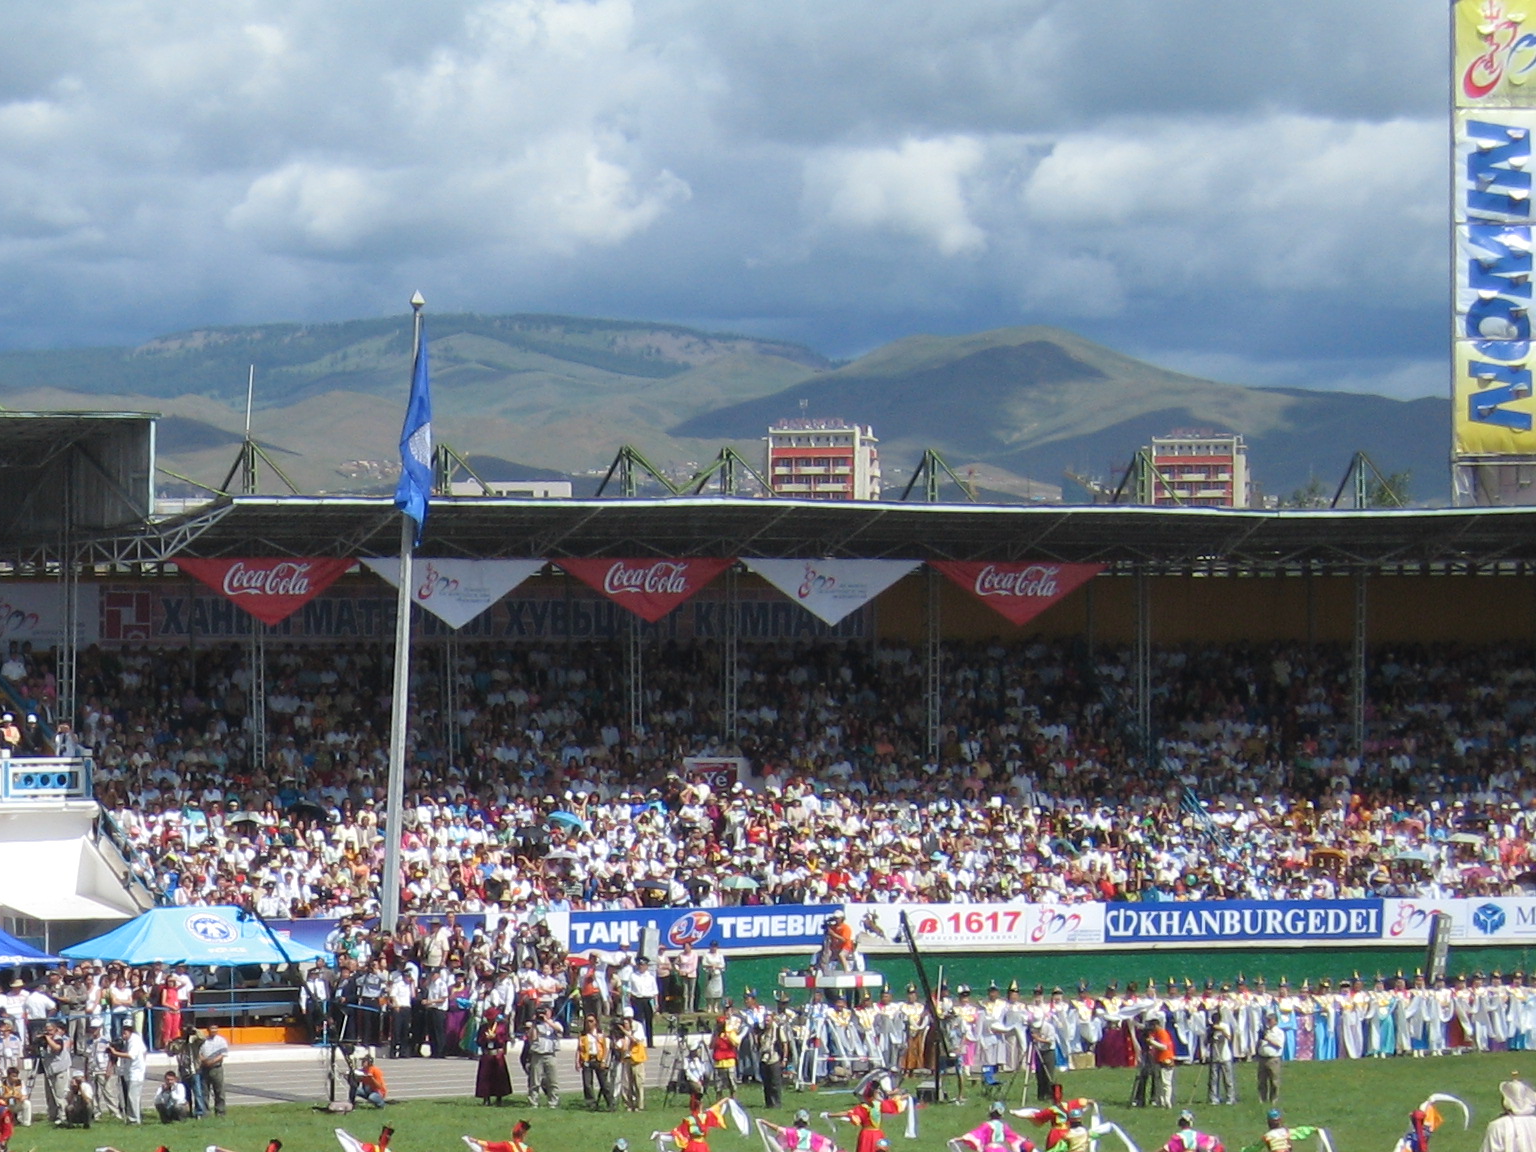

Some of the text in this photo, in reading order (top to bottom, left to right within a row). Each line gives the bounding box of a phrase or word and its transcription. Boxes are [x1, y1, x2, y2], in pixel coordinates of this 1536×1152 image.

[1466, 119, 1533, 431] NOMIN
[223, 562, 312, 595] Coca-Cola
[604, 561, 689, 594] Coca-Cola
[975, 565, 1060, 597] Coca-Cola
[303, 598, 492, 636] МАТЕРИЛ
[946, 911, 1022, 934] 1617
[1137, 907, 1379, 937] KHANBURGEDEI
